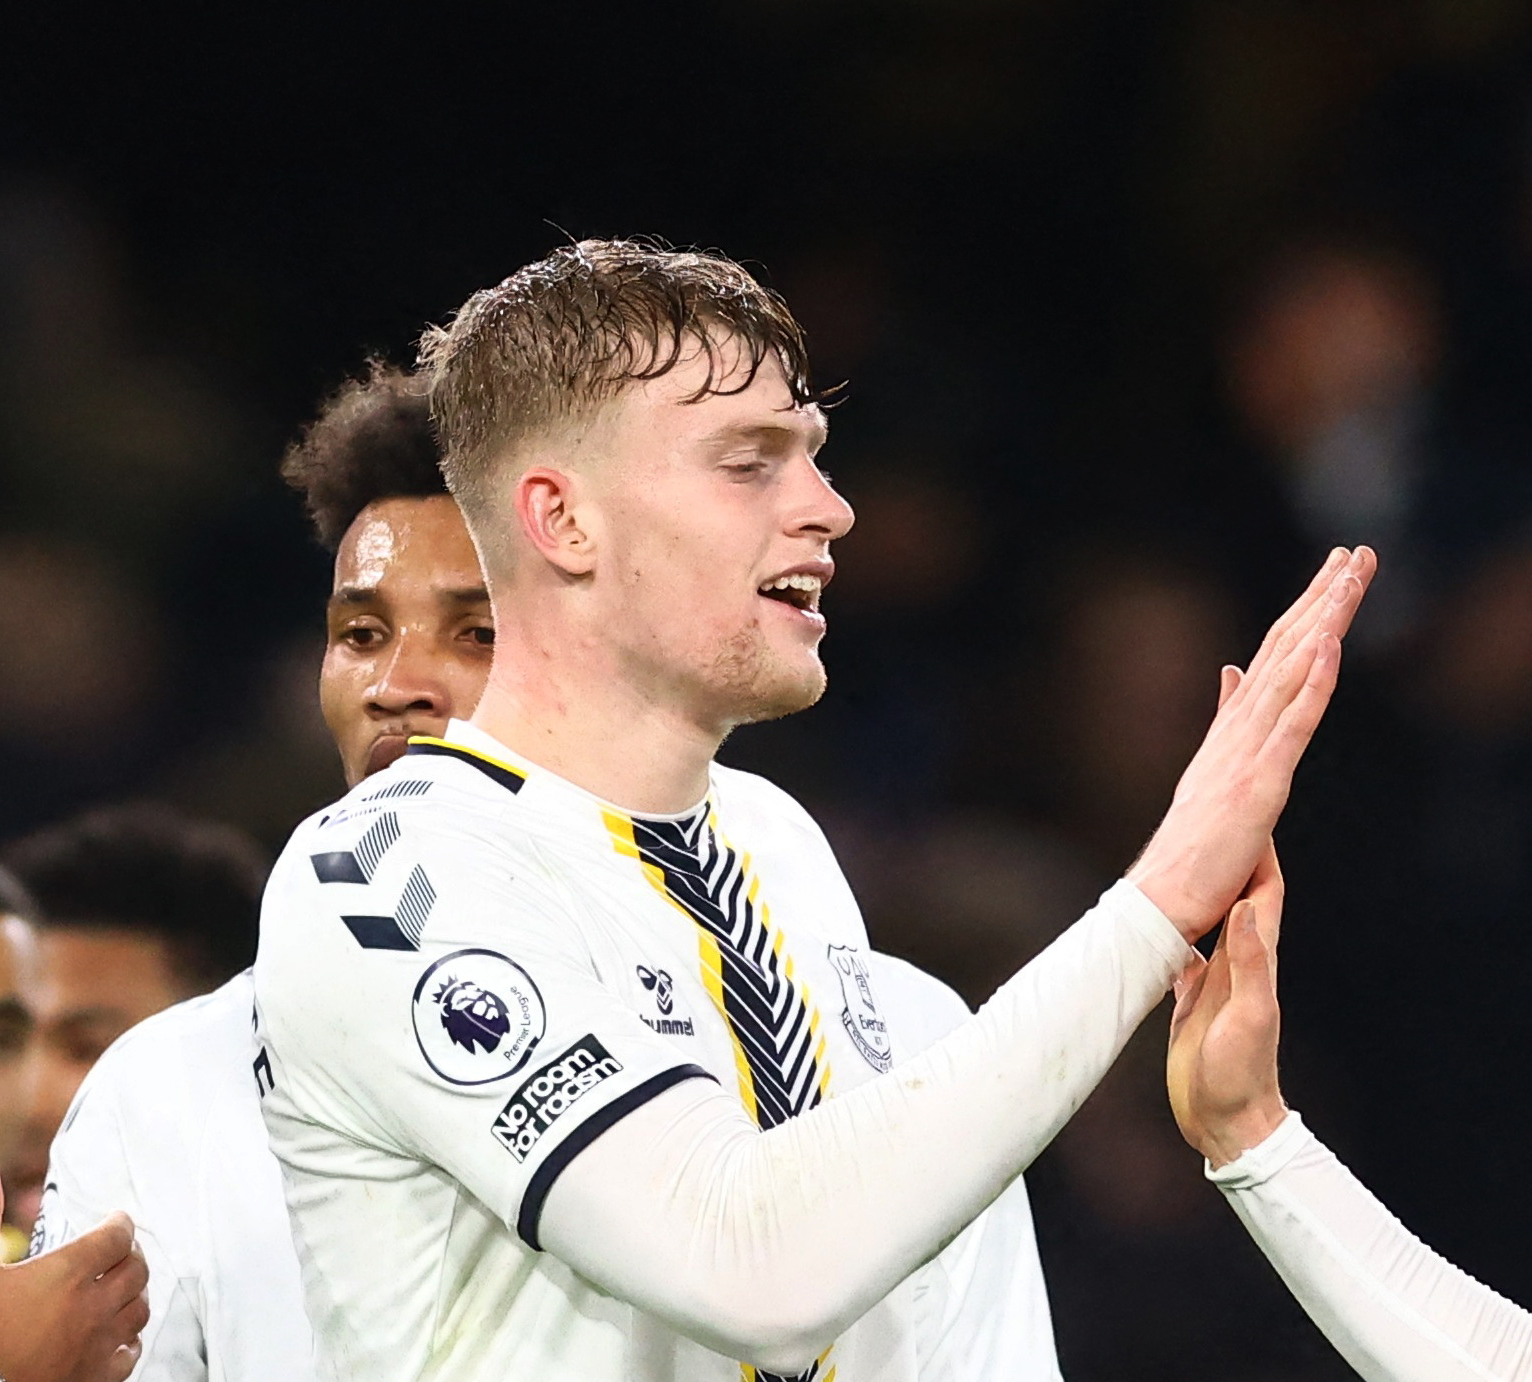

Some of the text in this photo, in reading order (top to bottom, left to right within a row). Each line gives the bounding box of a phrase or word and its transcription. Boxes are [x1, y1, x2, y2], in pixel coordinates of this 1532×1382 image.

[503, 985, 531, 1061] Premier League
[491, 1048, 597, 1143] No room
[509, 1057, 624, 1163] for racism
